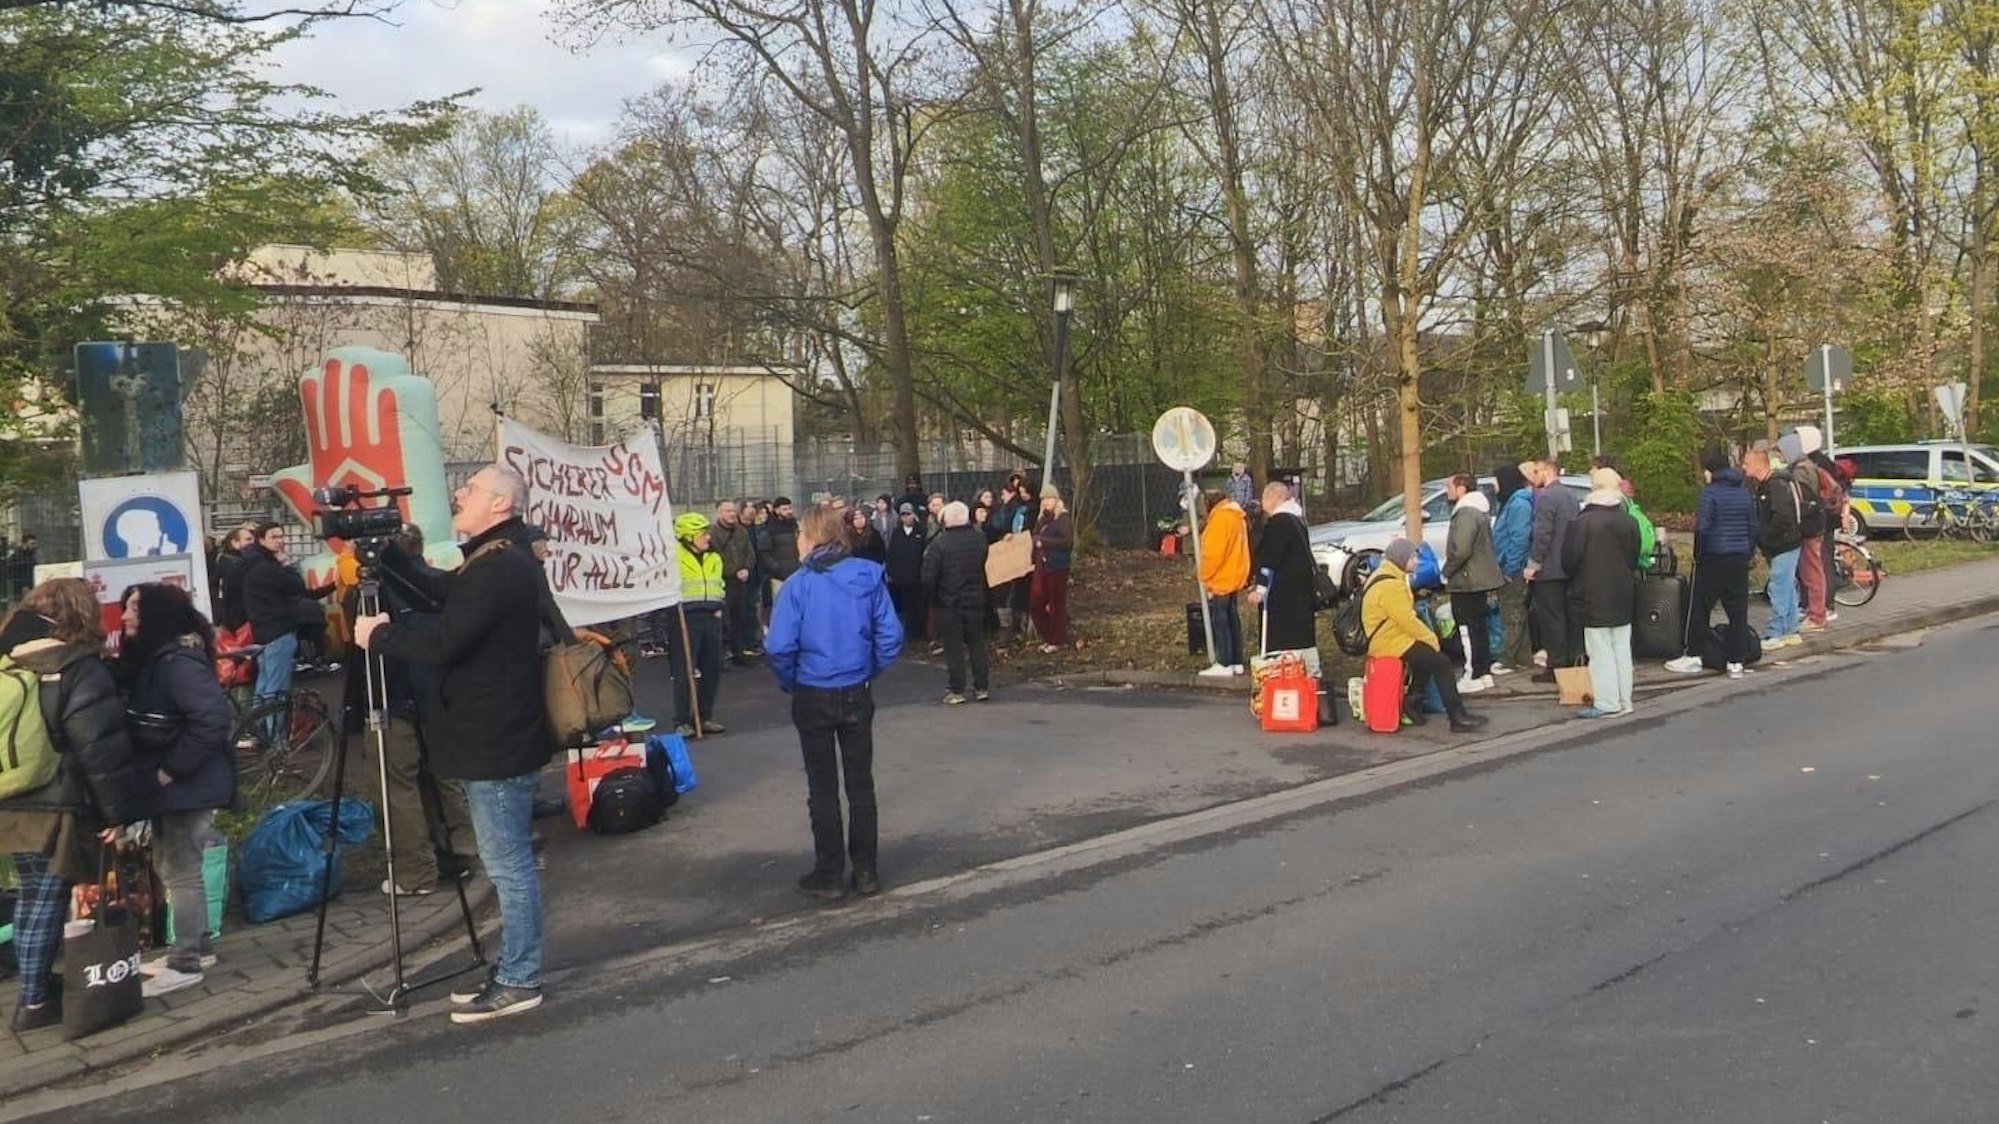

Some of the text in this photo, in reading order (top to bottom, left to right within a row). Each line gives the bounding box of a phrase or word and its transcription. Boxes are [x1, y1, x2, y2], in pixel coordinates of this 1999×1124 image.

[505, 446, 616, 500] SICHERER
[603, 443, 664, 515] SSM
[551, 549, 581, 592] ÜR
[583, 552, 635, 591] ALLE
